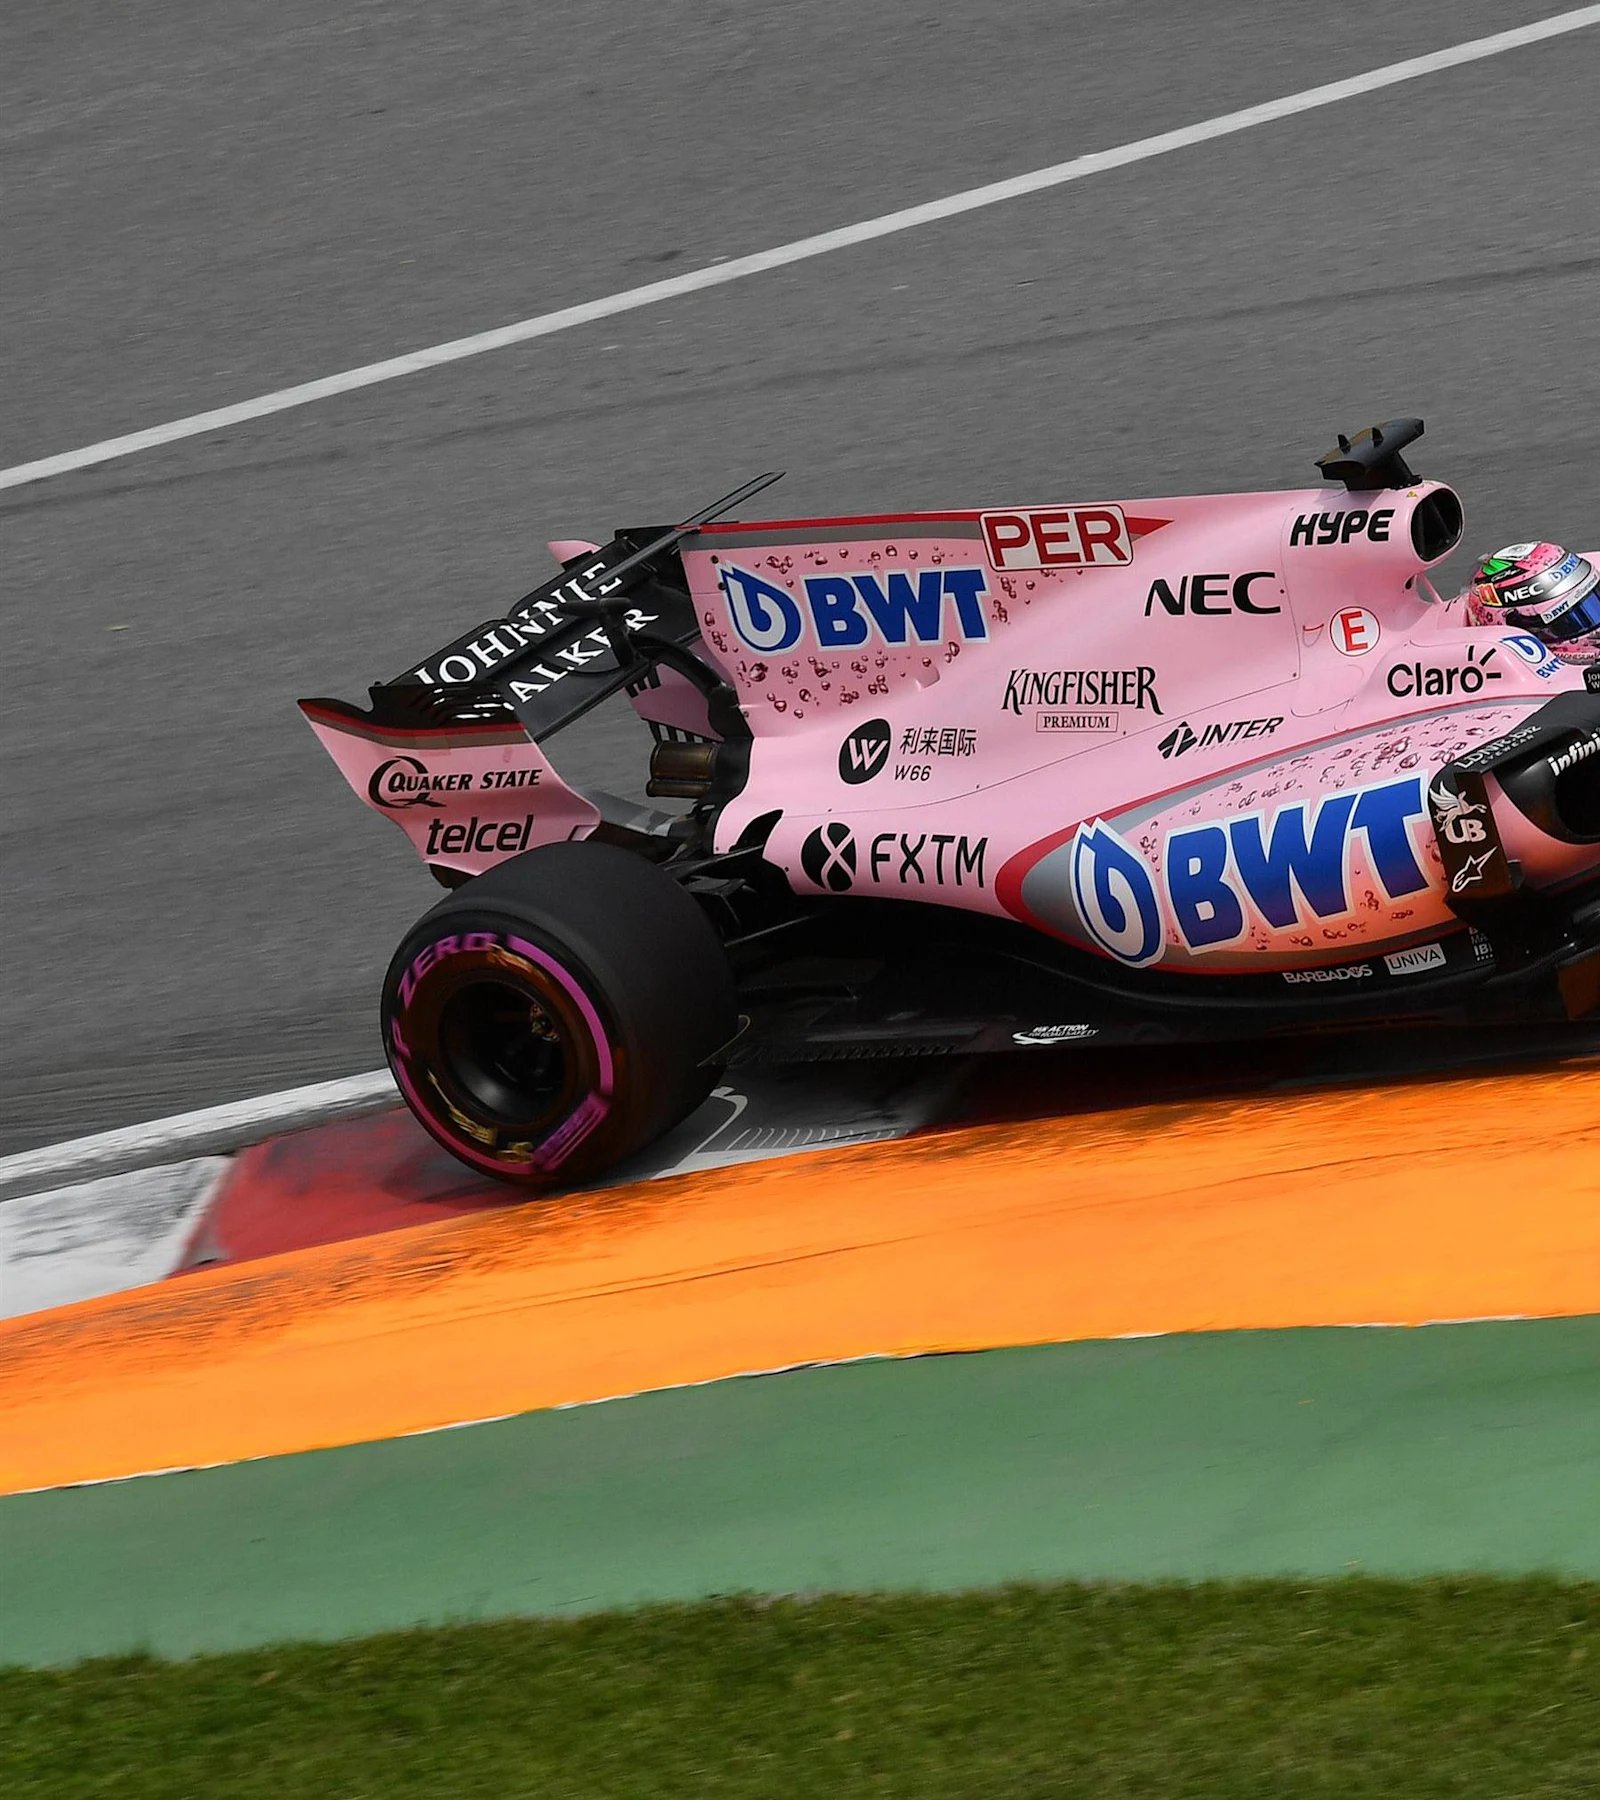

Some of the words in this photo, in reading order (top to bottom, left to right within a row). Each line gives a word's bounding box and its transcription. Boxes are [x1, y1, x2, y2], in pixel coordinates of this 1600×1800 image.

[986, 510, 1129, 567] PER
[1289, 509, 1395, 547] HYPE
[804, 569, 988, 648] BWT
[1144, 571, 1282, 617] NEC
[1504, 582, 1545, 603] NEC
[1343, 611, 1368, 651] E
[1387, 662, 1484, 698] Claro
[1537, 659, 1568, 679] BWT
[1001, 666, 1165, 716] KINGFISHER
[1042, 716, 1110, 729] PREMIUM
[1198, 717, 1284, 747] INTER
[899, 728, 977, 758] 利来国际
[388, 772, 473, 793] QUAKER
[480, 769, 543, 789] STATE
[894, 764, 931, 782] W66
[426, 814, 534, 855] telcel
[1446, 819, 1487, 844] UB
[871, 832, 988, 888] FXTM
[1165, 777, 1430, 950] BWT
[1282, 964, 1374, 984] BARBADOS
[1389, 948, 1442, 969] UNIVA
